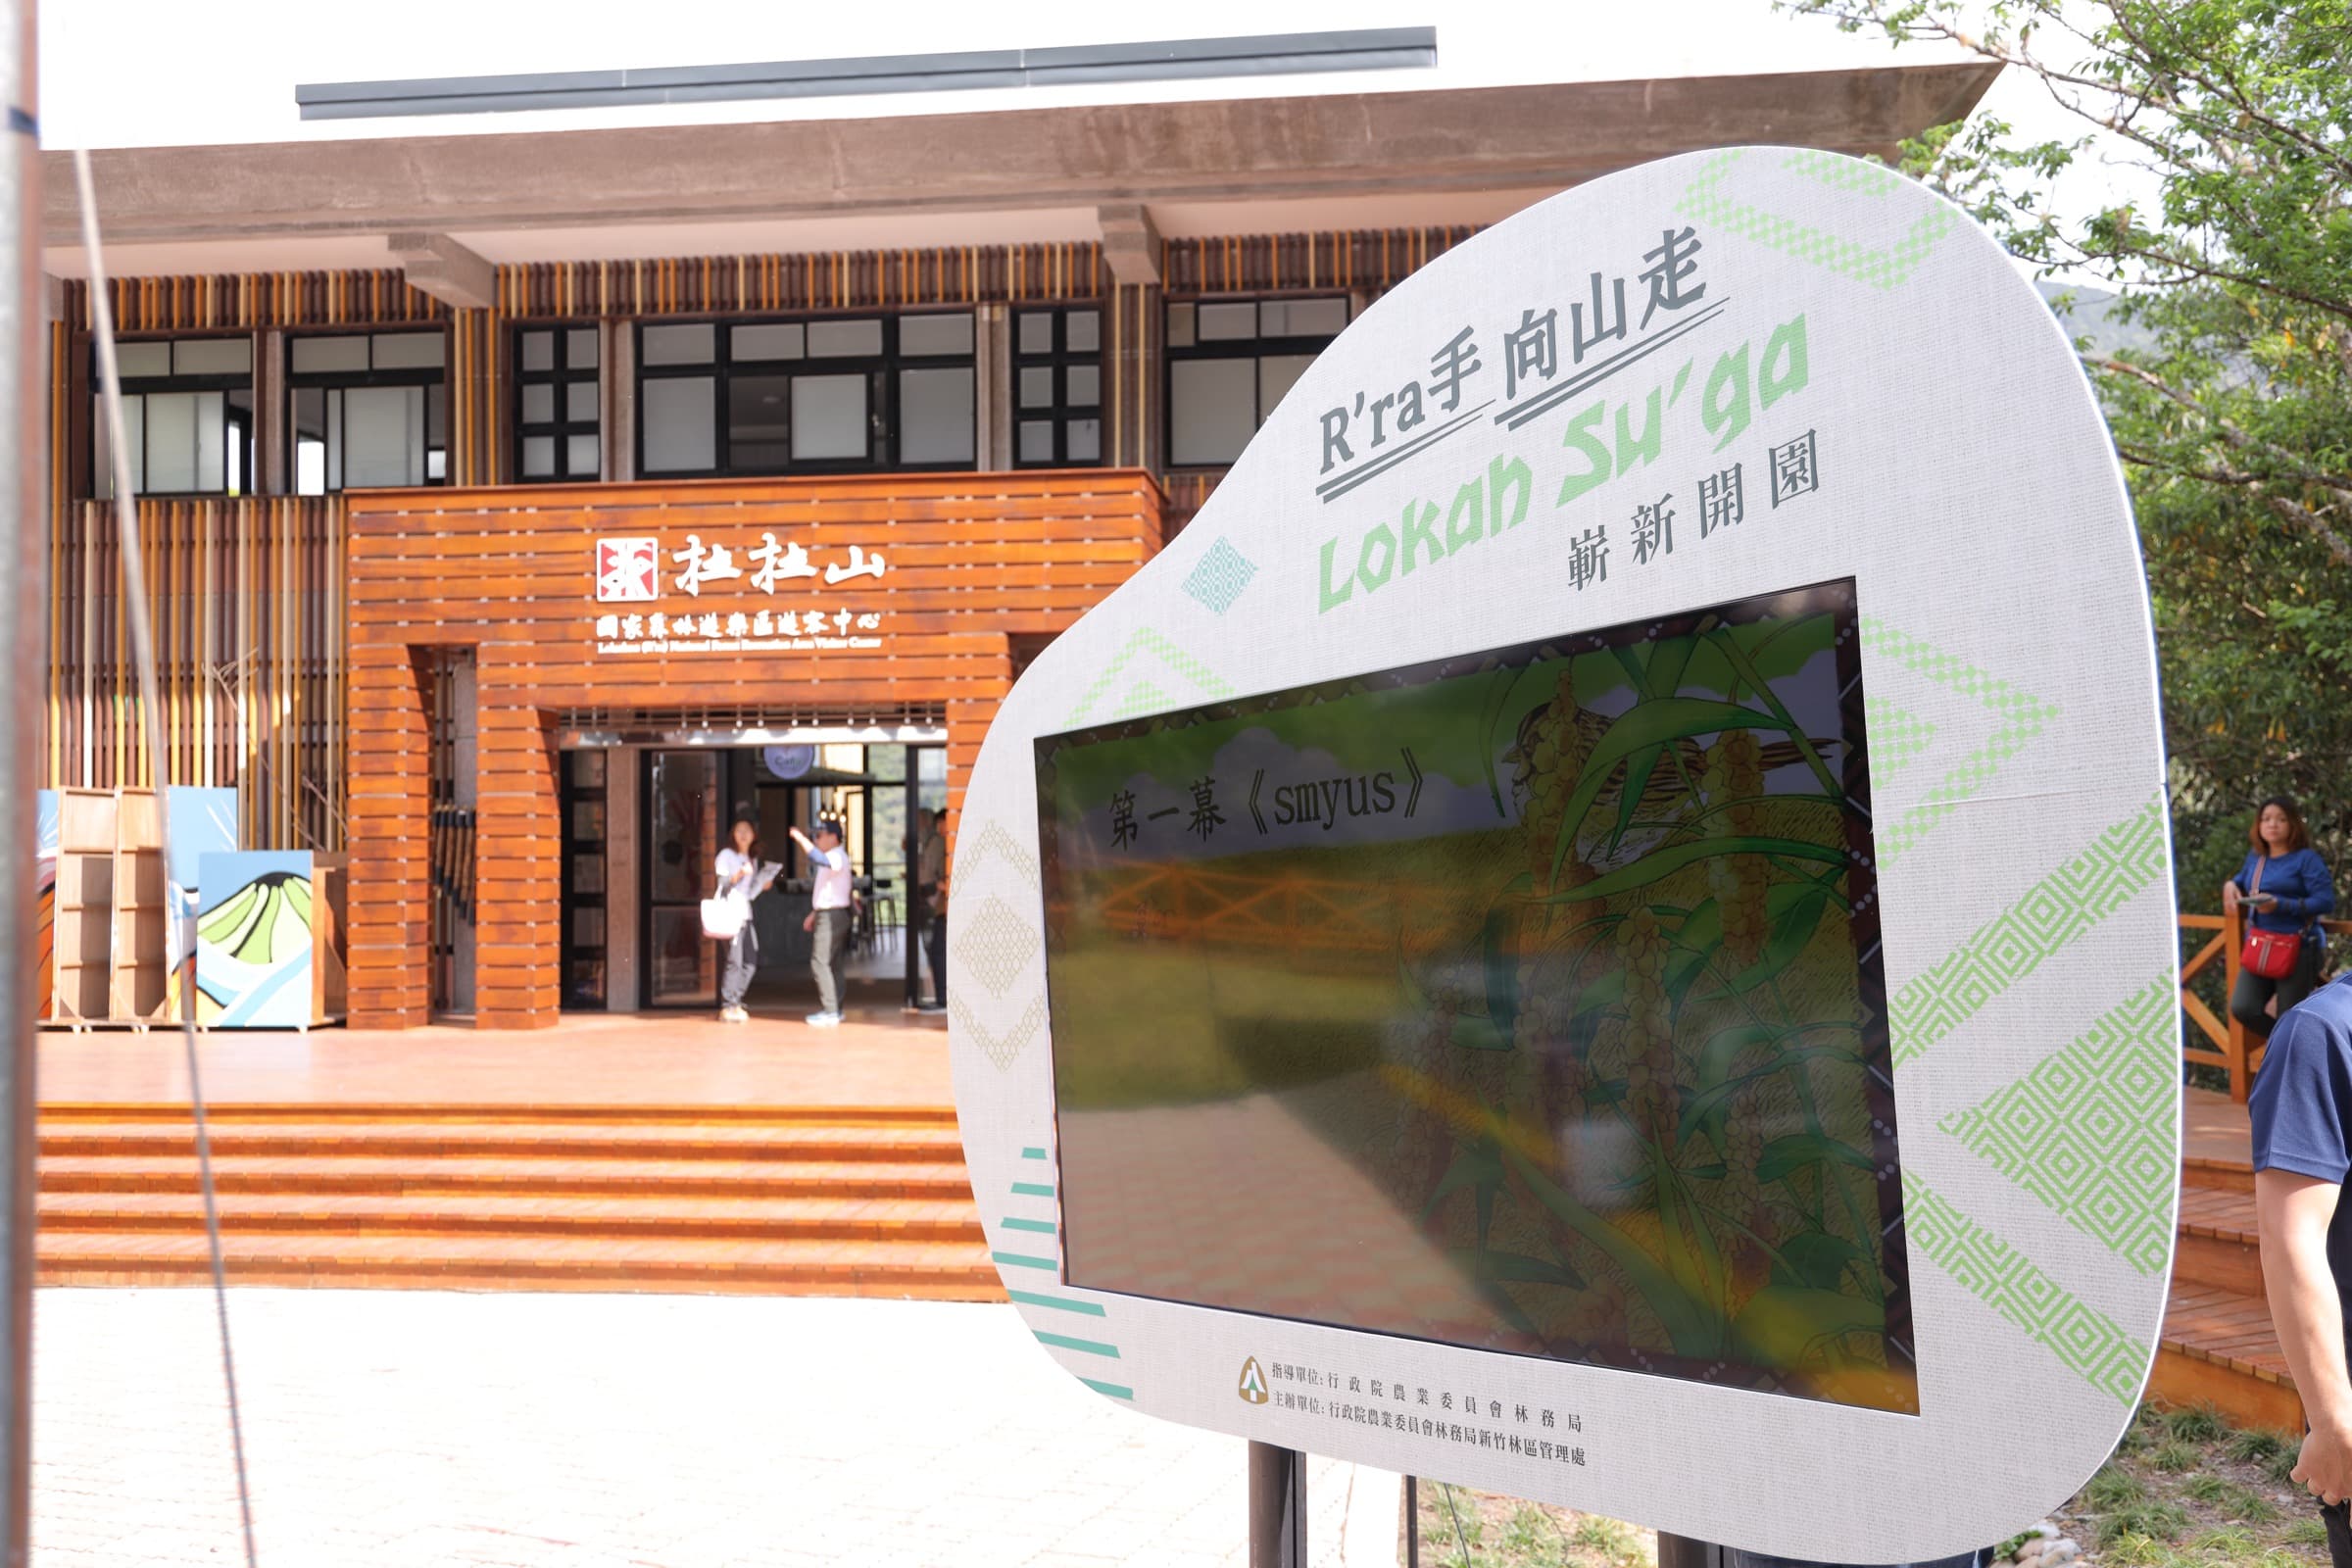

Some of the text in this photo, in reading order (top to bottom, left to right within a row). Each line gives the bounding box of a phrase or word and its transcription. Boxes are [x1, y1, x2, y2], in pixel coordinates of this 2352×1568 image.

[1503, 226, 1707, 400] 向山走
[672, 532, 886, 597] 拉拉山
[1567, 428, 1820, 592] 嶄新開園
